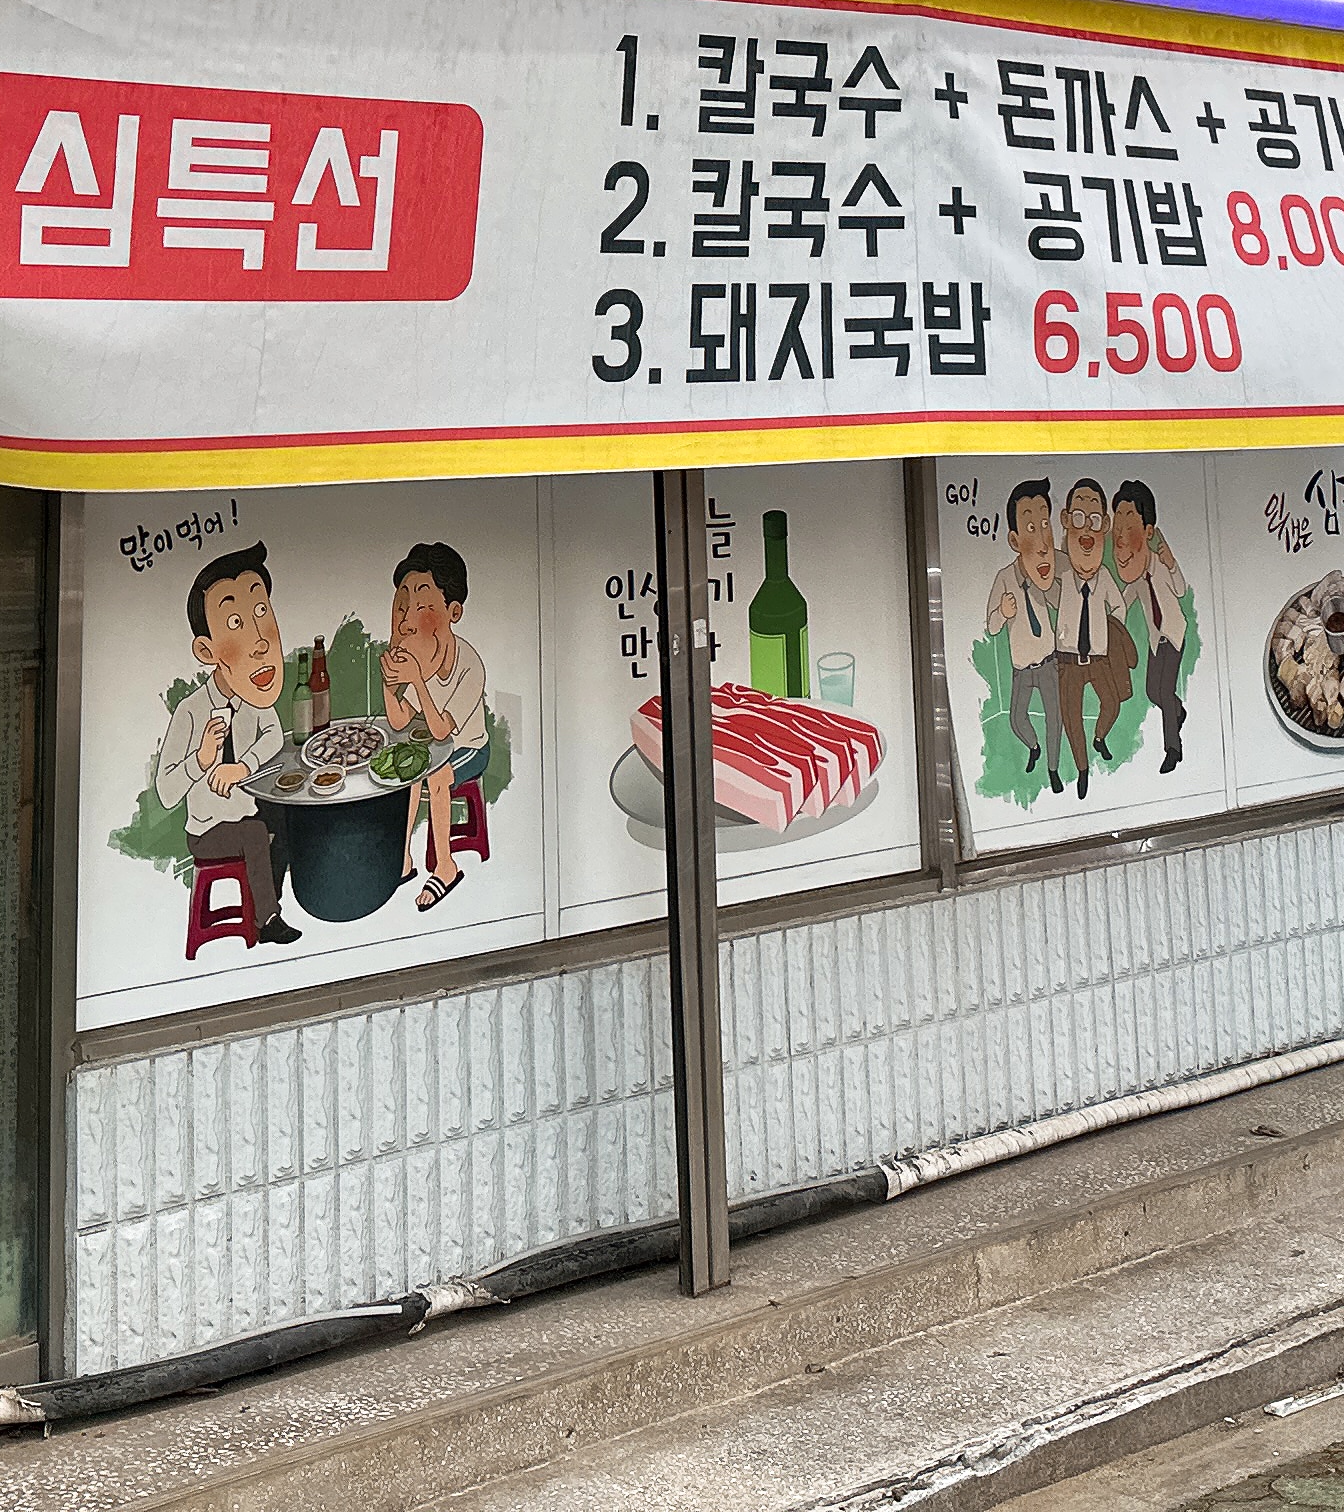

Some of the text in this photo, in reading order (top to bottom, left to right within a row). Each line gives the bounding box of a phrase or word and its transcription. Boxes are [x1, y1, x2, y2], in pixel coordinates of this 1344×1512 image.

[616, 34, 660, 131] 1.
[698, 34, 902, 138] 칼국수
[934, 72, 968, 119] +
[997, 59, 1178, 162] 돈까스
[1196, 101, 1225, 144] +
[600, 160, 666, 257] 2.
[691, 159, 906, 257] 칼국수
[939, 186, 977, 235] +
[1024, 171, 1207, 267] 공기밥
[592, 288, 662, 385] 3.
[686, 281, 991, 383] 돼지국밥
[945, 477, 979, 505] GO!
[966, 513, 1000, 542] GO!
[120, 524, 173, 572] 많이
